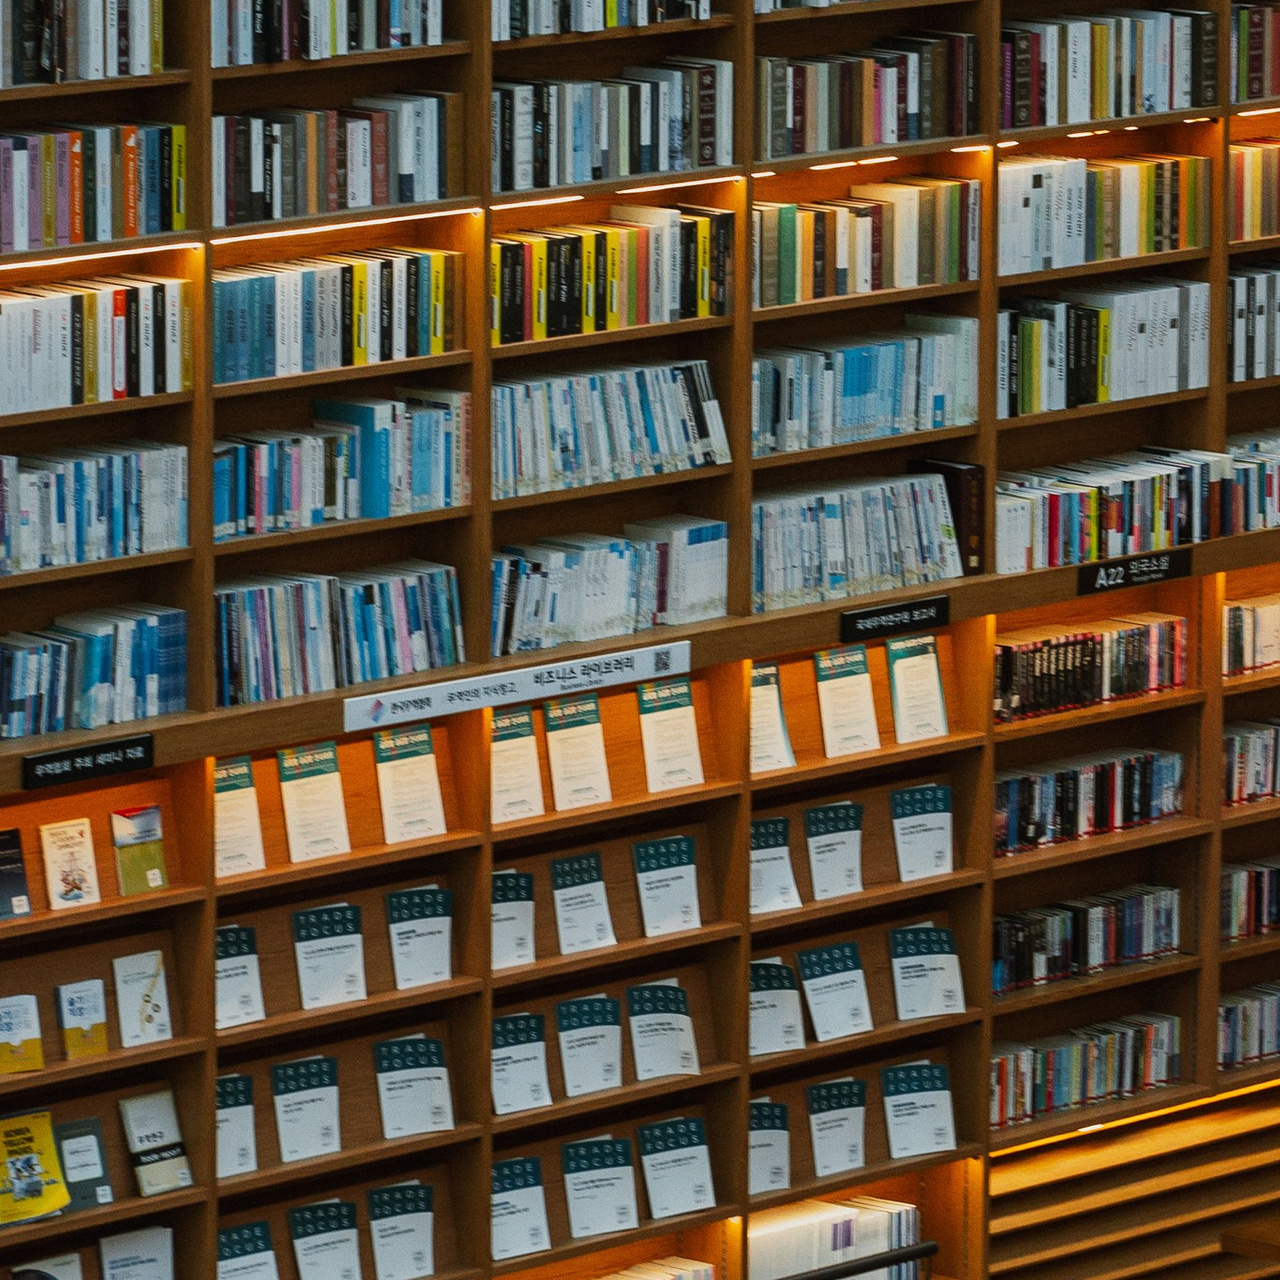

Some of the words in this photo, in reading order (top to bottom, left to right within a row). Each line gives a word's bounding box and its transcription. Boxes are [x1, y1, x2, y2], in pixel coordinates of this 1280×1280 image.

[1095, 567, 1124, 588] A22
[533, 668, 577, 686] 비즈니스
[580, 657, 634, 677] 라이브러리
[894, 790, 945, 802] TRADE
[809, 807, 858, 821] TRADE
[895, 801, 945, 813] FOCUS
[811, 819, 860, 834] FOCUS
[638, 841, 691, 856] TRADE
[555, 856, 597, 874] TRADE
[639, 853, 691, 868] FOCUS
[557, 871, 598, 887] FOCUS
[391, 893, 446, 906] TRADE
[300, 910, 355, 923] TRADE
[391, 905, 445, 918] FOCUS
[300, 923, 355, 936] FOCUS
[894, 931, 950, 943] TRADE
[895, 941, 951, 954] FOCUS
[801, 947, 852, 963] TRADE
[804, 959, 853, 975] FOCUS
[631, 987, 685, 1000] TRADE
[561, 1001, 614, 1015] TRADE
[633, 1001, 687, 1014] FOCUS
[562, 1013, 614, 1027] FOCUS
[380, 1042, 438, 1057] TRADE
[379, 1055, 438, 1069] FOCUS
[277, 1062, 330, 1077] TRADE
[888, 1068, 941, 1082] TRADE
[277, 1075, 331, 1091] FOCUS
[811, 1084, 860, 1096] TRADE
[889, 1079, 942, 1092] FOCUS
[812, 1095, 860, 1109] FOCUS
[642, 1123, 699, 1140] TRADE
[644, 1134, 701, 1151] FOCUS
[568, 1144, 625, 1157] TRADE
[569, 1156, 625, 1171] FOCUS
[371, 1188, 426, 1203] TRADE
[293, 1206, 349, 1221] TRADE
[373, 1201, 427, 1215] FOCUS
[295, 1219, 351, 1235] FOCUS
